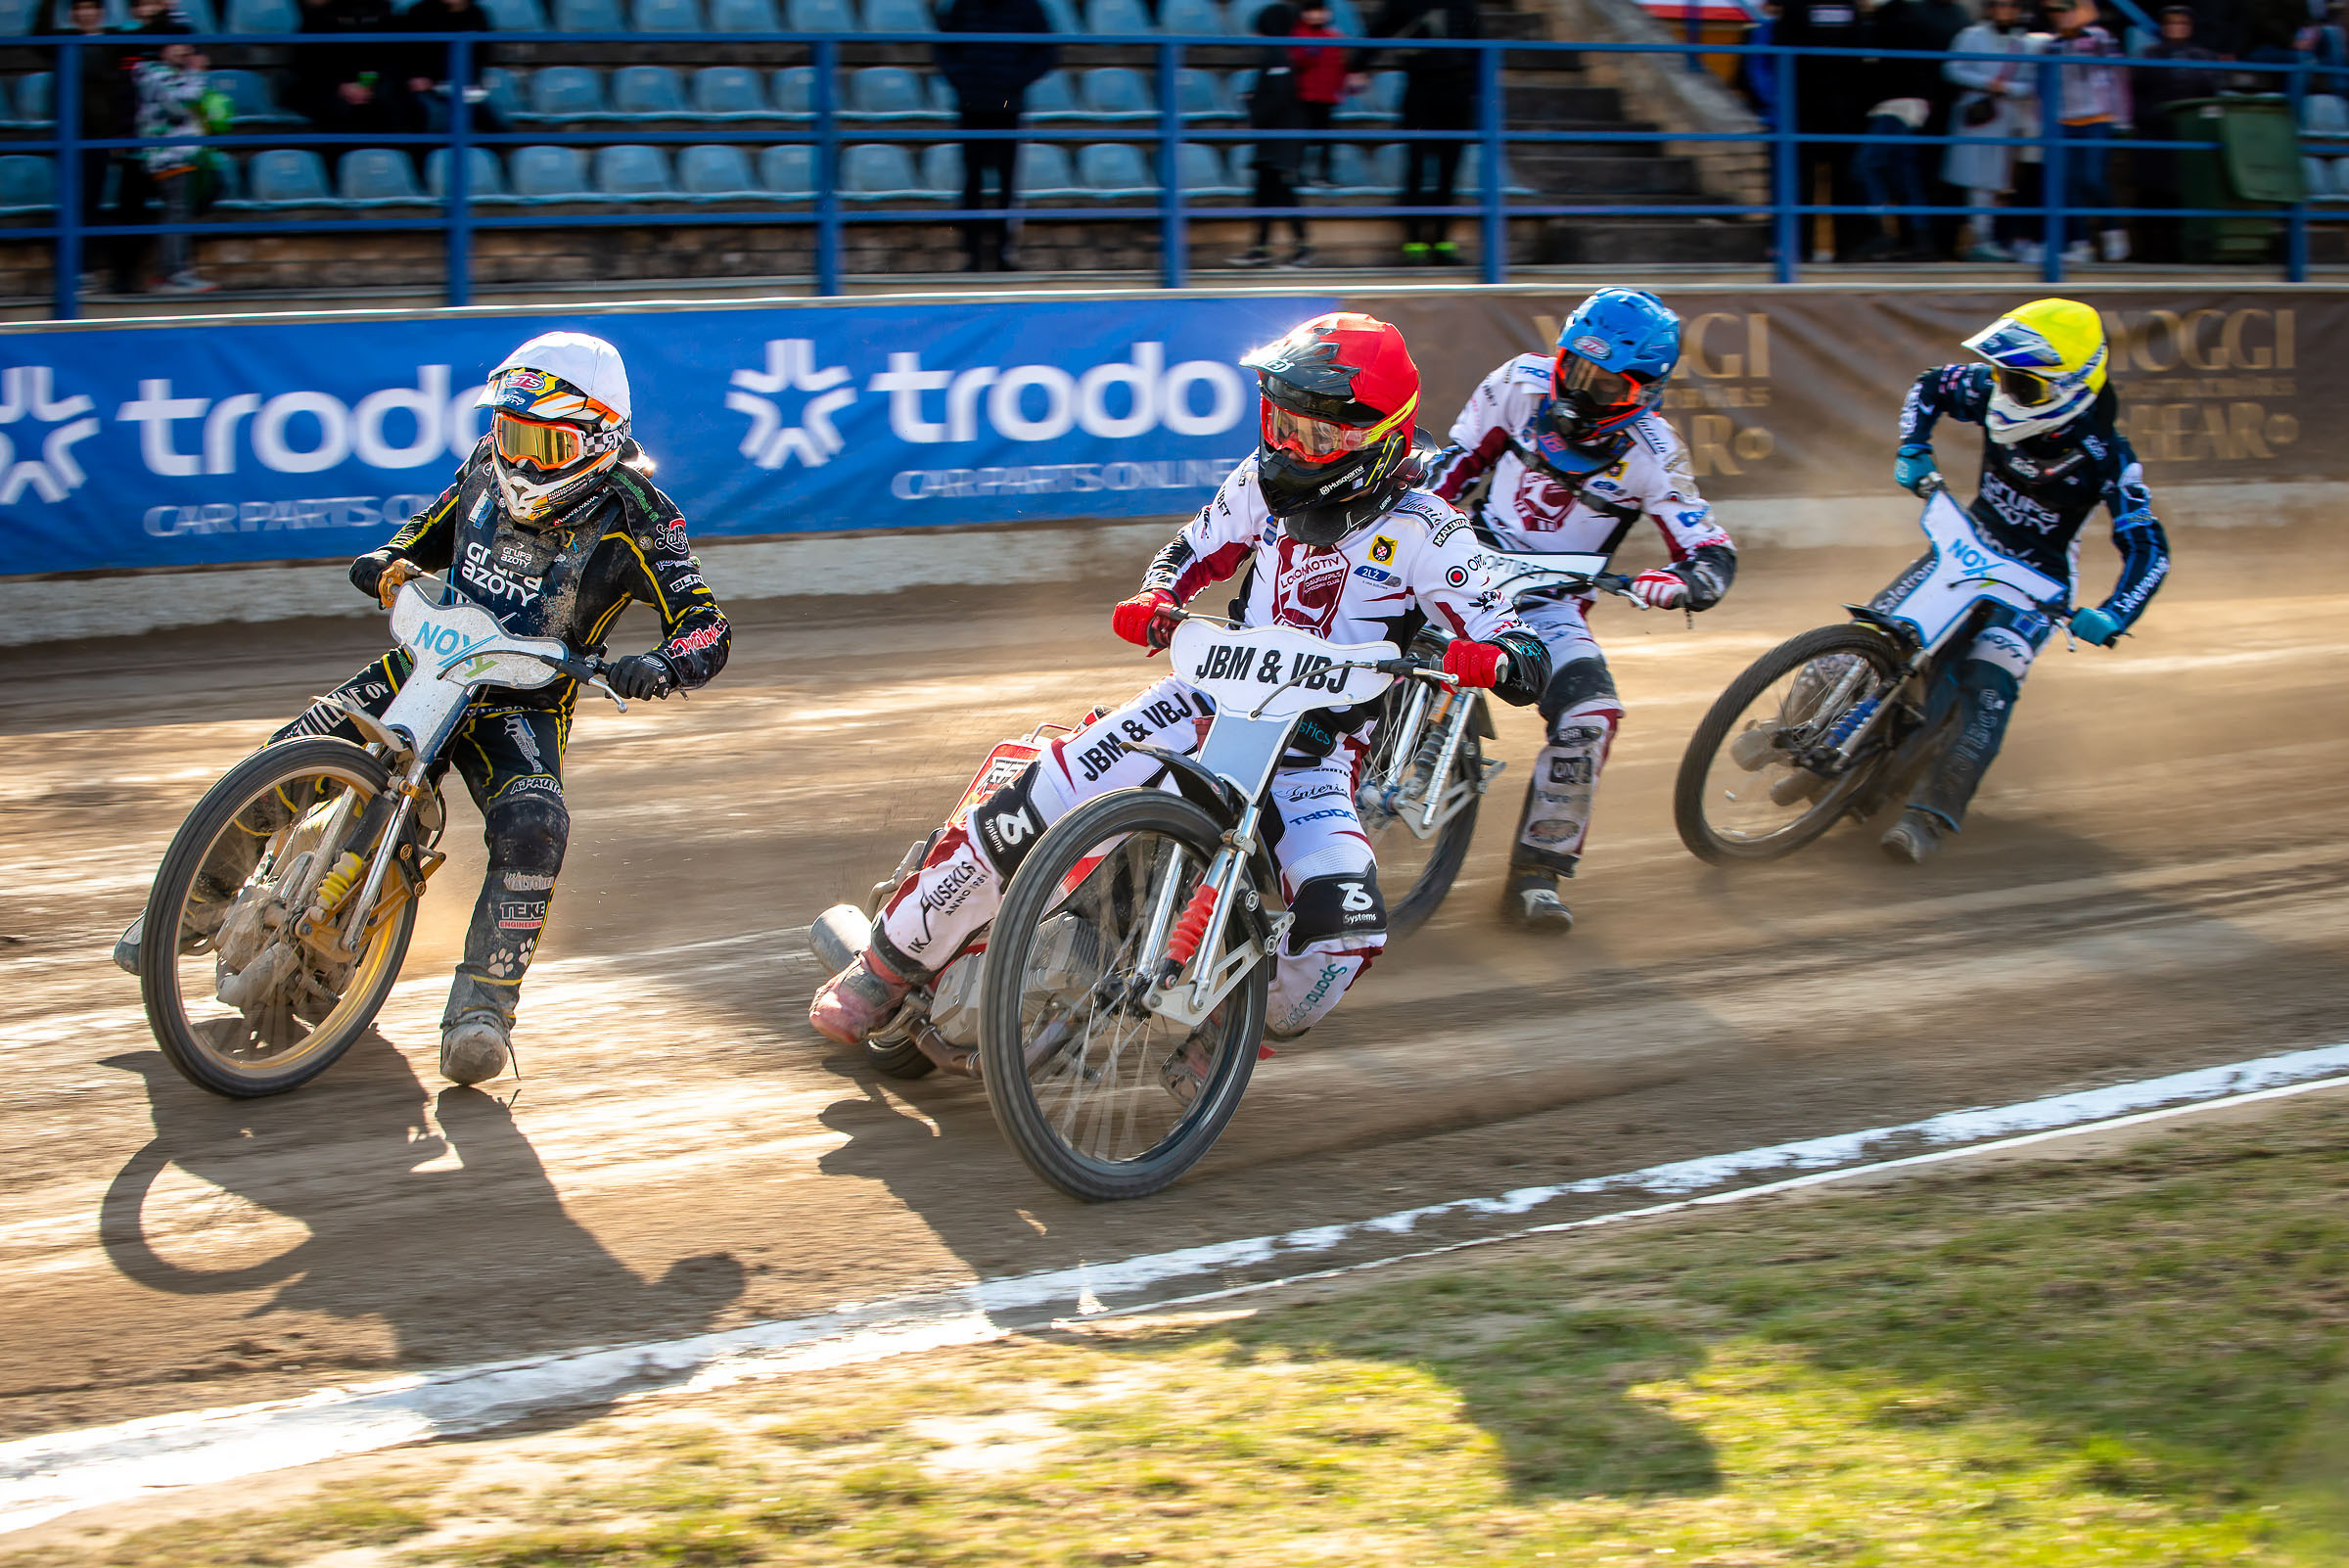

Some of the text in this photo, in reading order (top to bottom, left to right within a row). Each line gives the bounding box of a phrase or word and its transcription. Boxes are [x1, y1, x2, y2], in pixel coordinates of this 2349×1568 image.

[868, 342, 1246, 442] trodo
[1329, 464, 1364, 490] Husqvarna
[1195, 644, 1354, 695] JBM & VBJ
[1077, 692, 1192, 782] JBM & VBJ
[1298, 719, 1331, 745] stics
[945, 889, 971, 916] ANNO
[1343, 912, 1377, 925] Systems
